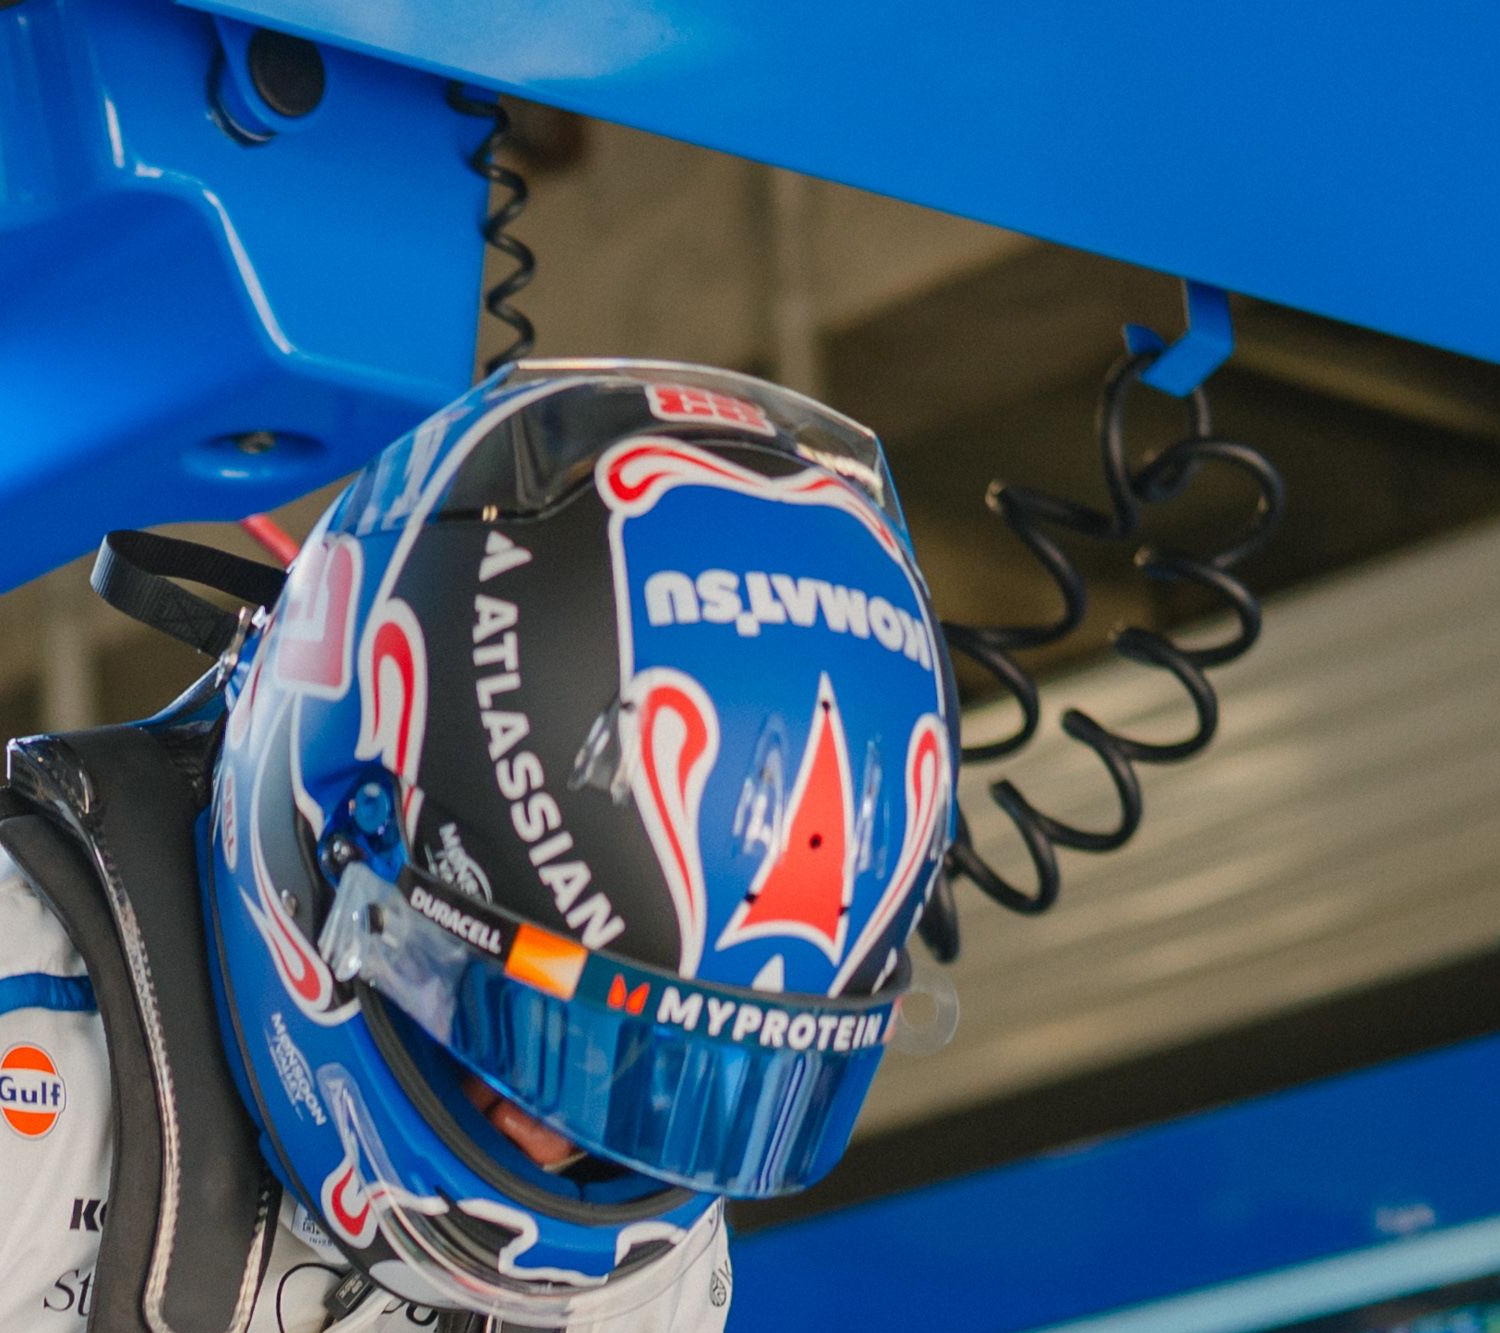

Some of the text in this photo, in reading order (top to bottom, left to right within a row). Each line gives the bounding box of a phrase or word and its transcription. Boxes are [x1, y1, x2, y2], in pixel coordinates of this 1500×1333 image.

[643, 568, 935, 671] KOMATSU
[472, 593, 627, 952] ATLASSIAN
[409, 884, 503, 955] DURACELL
[656, 985, 883, 1052] MYPROTEIN
